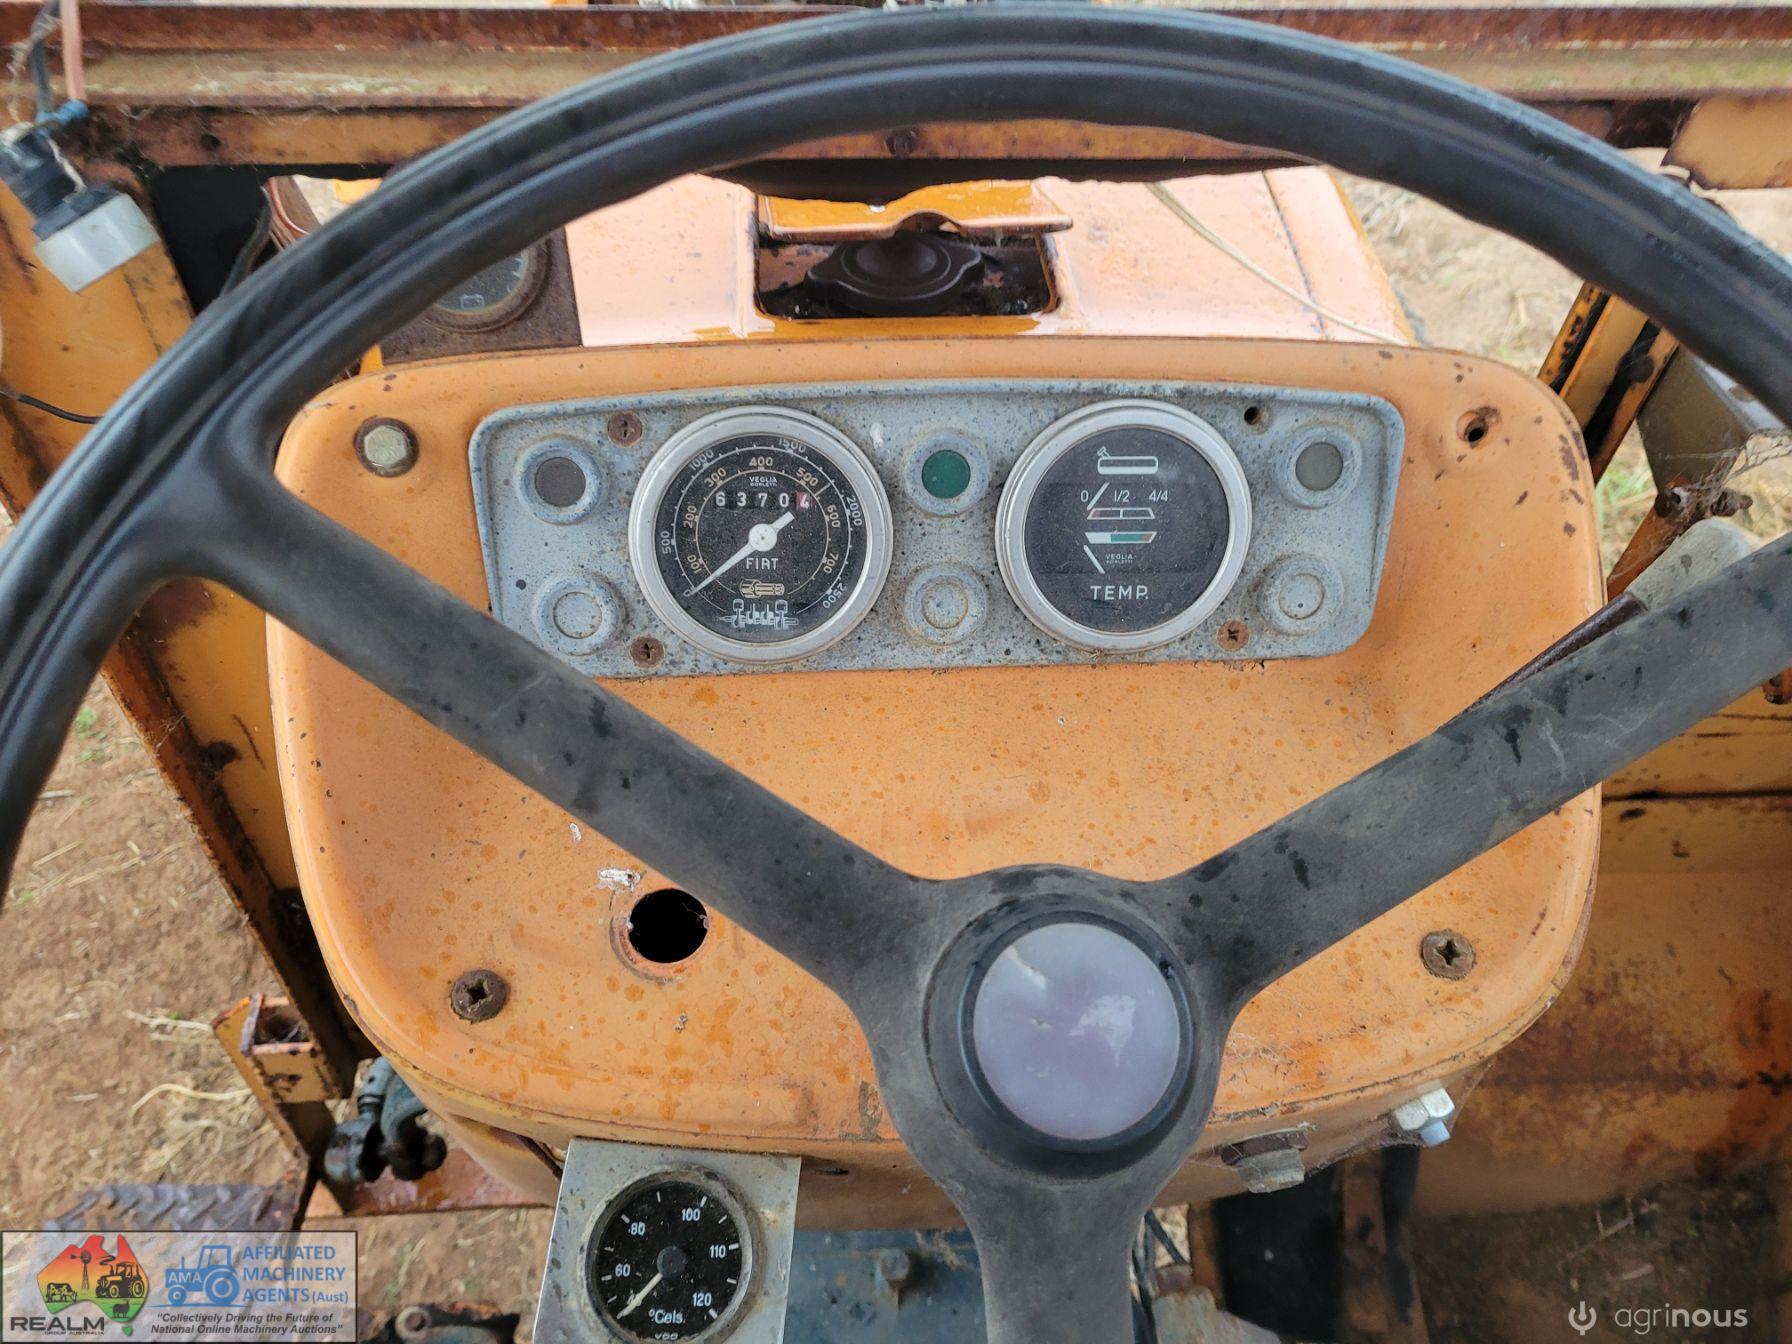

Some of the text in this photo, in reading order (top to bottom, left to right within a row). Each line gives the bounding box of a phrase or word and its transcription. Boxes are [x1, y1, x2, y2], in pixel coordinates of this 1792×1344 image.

[777, 437, 807, 454] 1500
[688, 449, 715, 471] 1000
[749, 456, 774, 468] 400
[704, 467, 727, 488] 300
[795, 466, 819, 487] 500
[1081, 490, 1089, 503] 0
[1148, 489, 1168, 503] 4/4
[683, 504, 698, 529] 200
[826, 503, 841, 529] 600
[845, 495, 863, 527] 2000
[661, 530, 672, 555] 500
[687, 554, 702, 574] 100
[746, 557, 779, 571] FIAT
[823, 550, 840, 574] 700
[822, 582, 847, 609] 2500
[1090, 585, 1149, 601] TEMP.
[681, 1208, 701, 1222] 100
[630, 1221, 646, 1236] 80
[709, 1244, 726, 1259] 110
[615, 1263, 631, 1277] 60
[692, 1292, 712, 1307] 120
